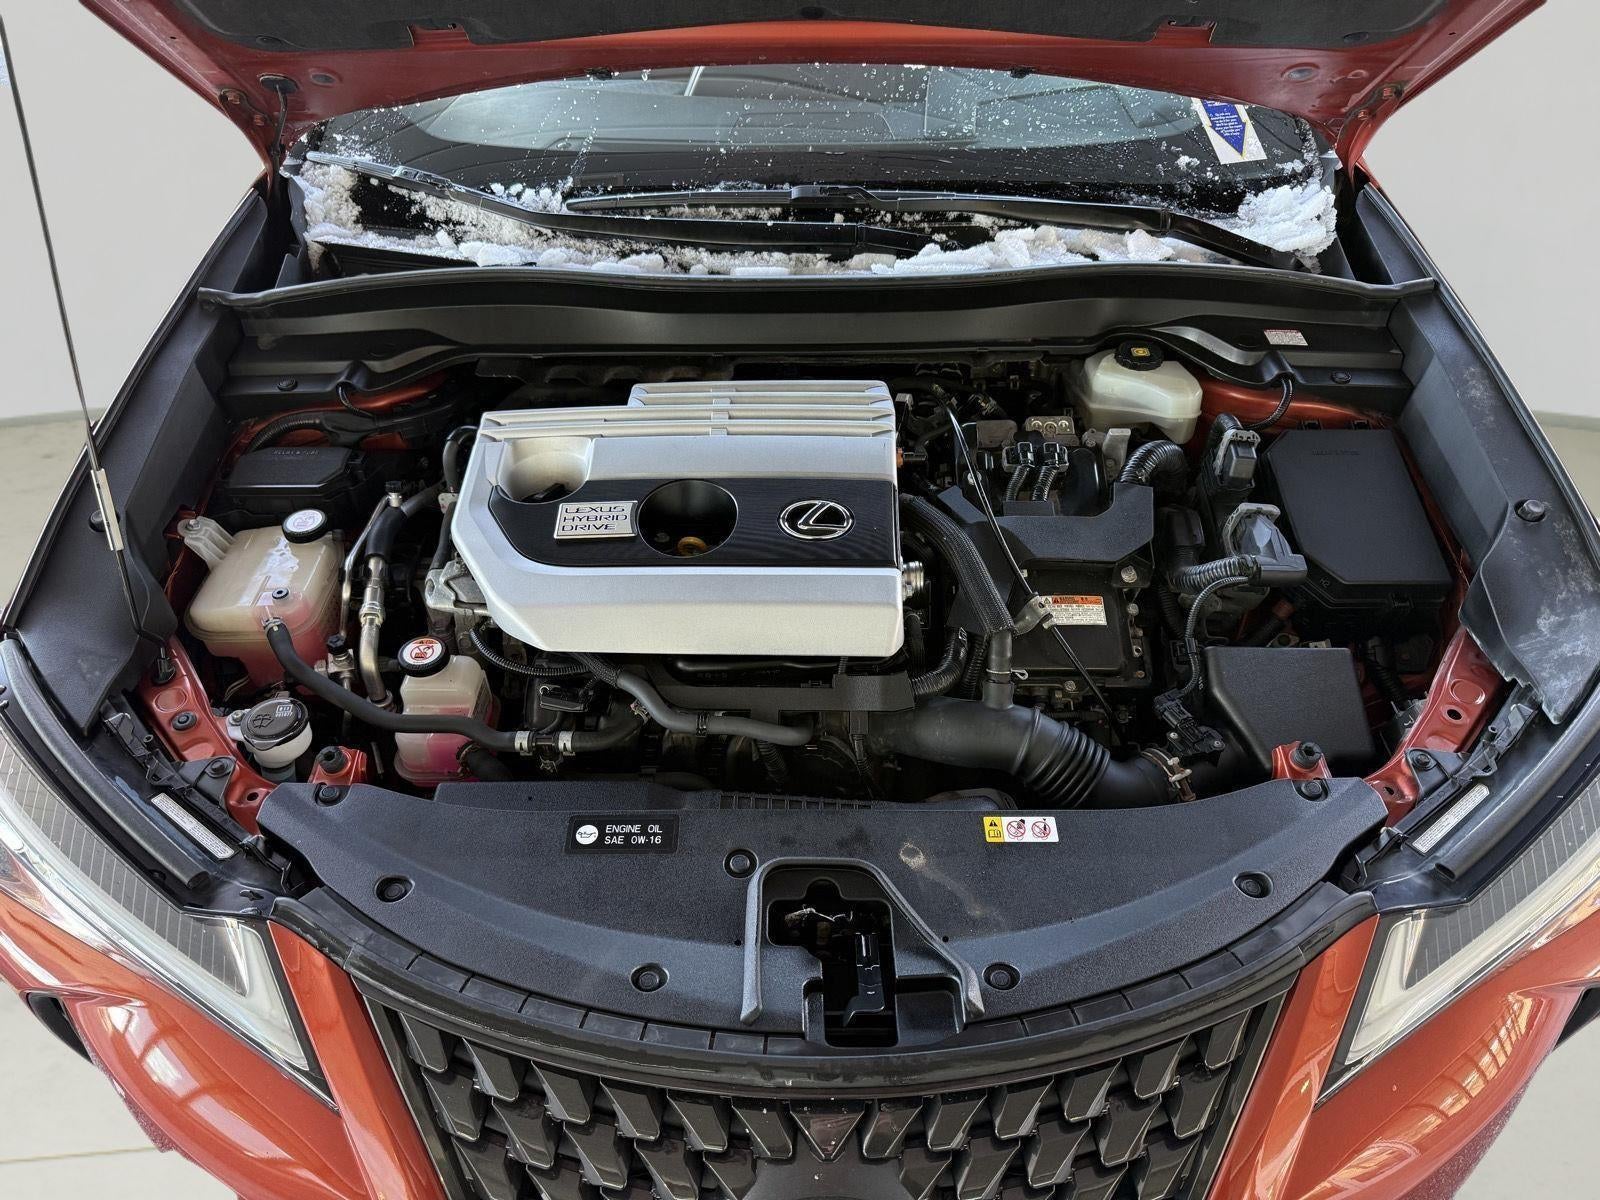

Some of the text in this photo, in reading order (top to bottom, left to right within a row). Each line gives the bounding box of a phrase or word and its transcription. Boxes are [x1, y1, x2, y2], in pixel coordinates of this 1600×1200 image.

[565, 505, 625, 514] LEXUS
[563, 514, 628, 523] HYBRID
[561, 523, 616, 532] DRIVE
[605, 824, 663, 833] ENGINE OIL
[604, 835, 662, 845] SAE 0W-16
